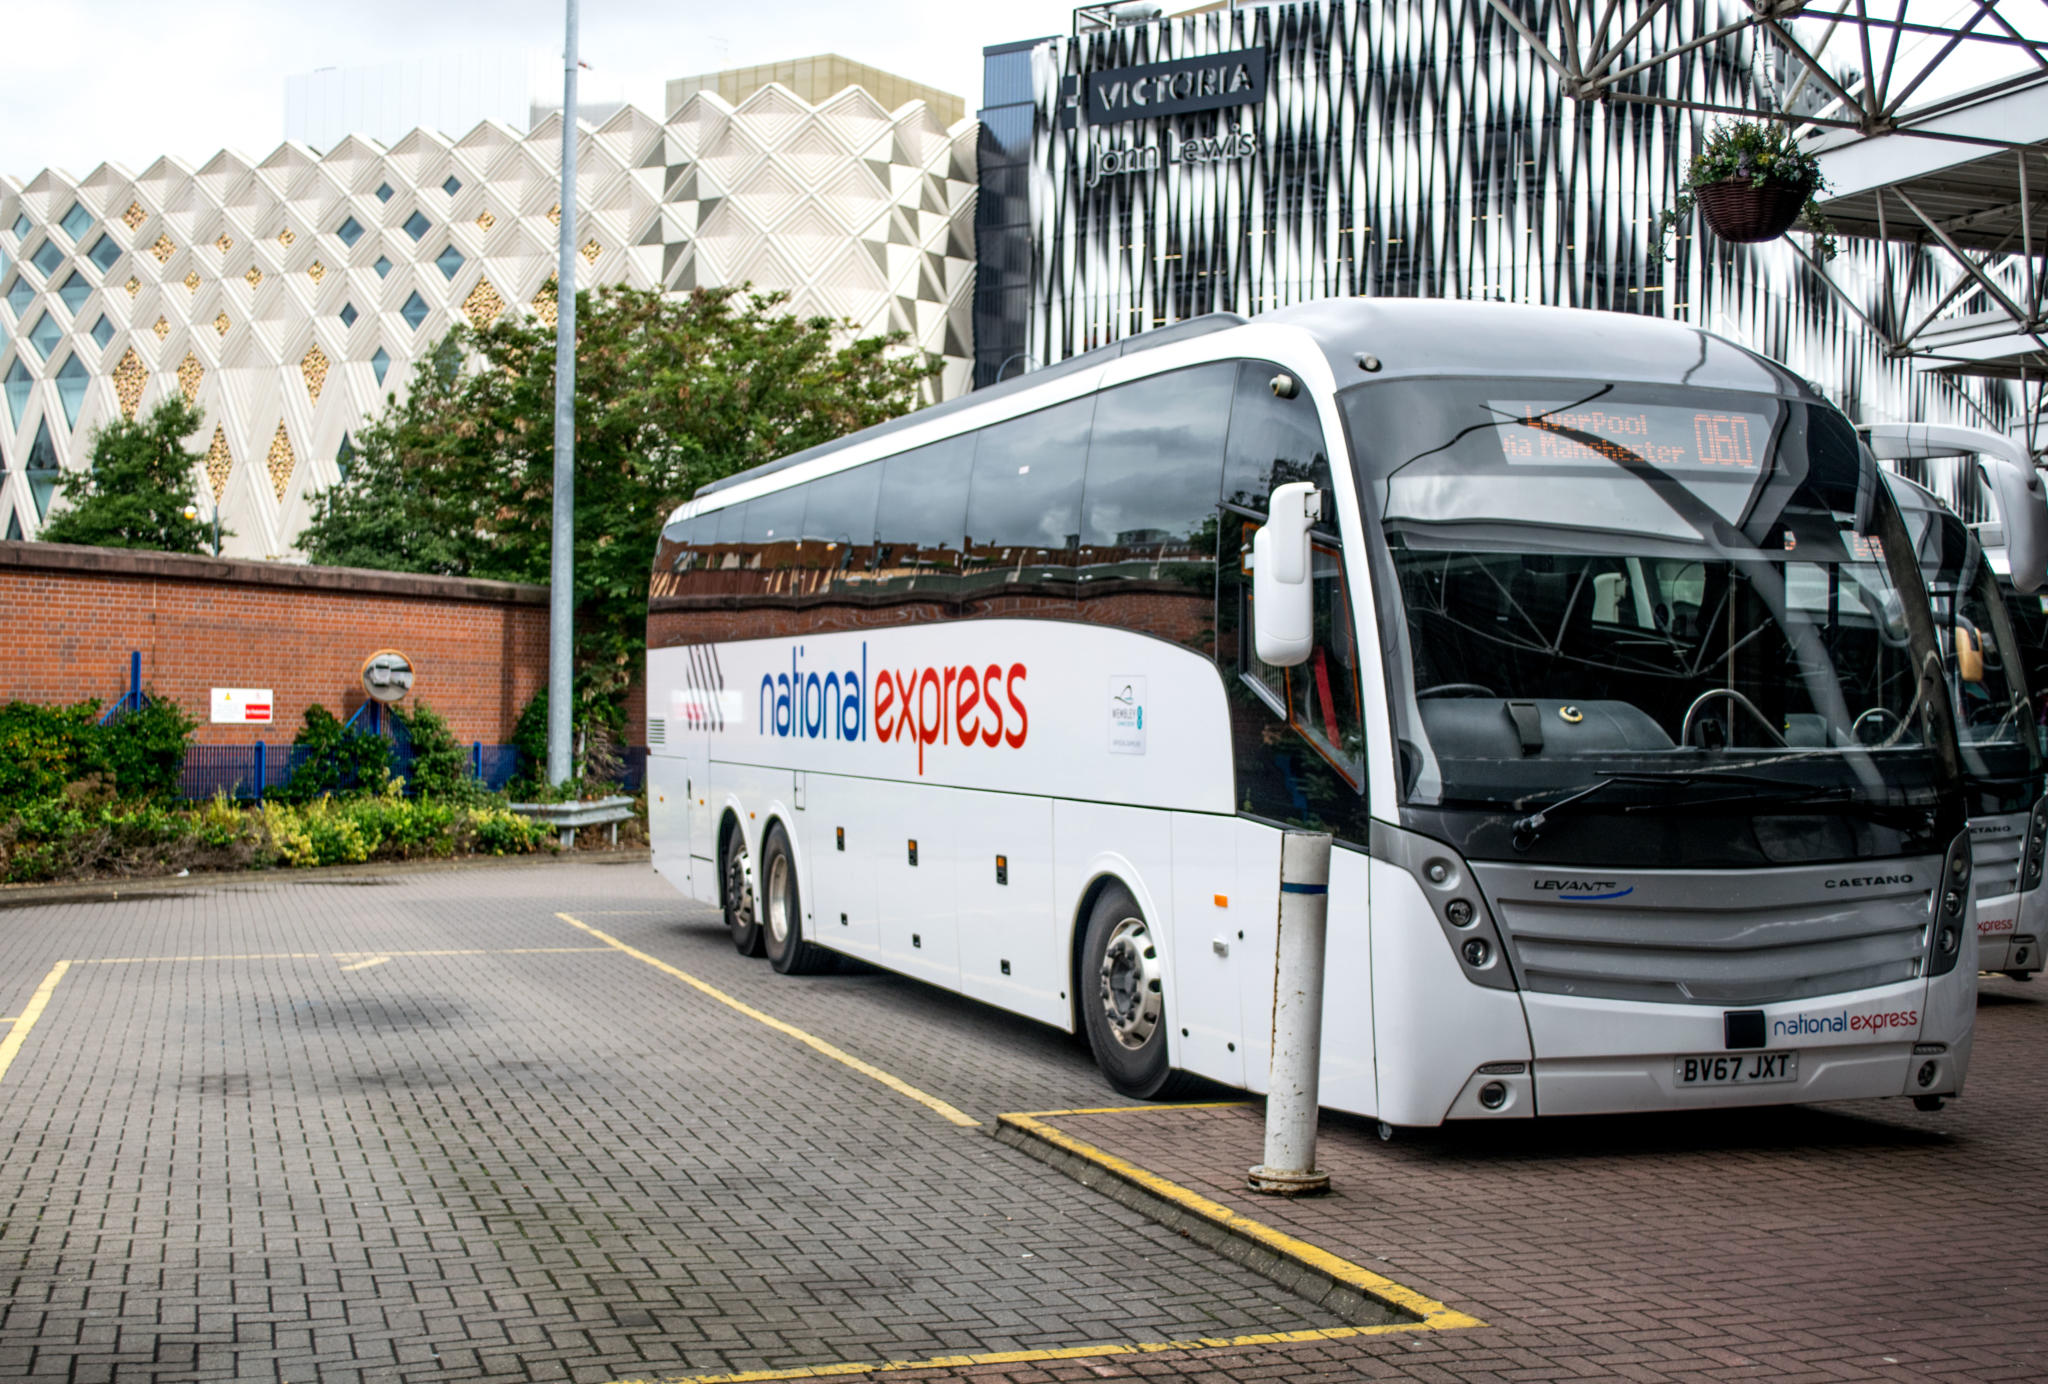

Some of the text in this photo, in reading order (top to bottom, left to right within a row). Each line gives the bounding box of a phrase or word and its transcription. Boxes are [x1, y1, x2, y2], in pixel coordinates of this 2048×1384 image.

[1098, 63, 1254, 111] VICTORIA
[1087, 122, 1257, 188] John Lewis
[1539, 431, 1685, 463] Manchester
[1694, 413, 1753, 466] 060
[760, 641, 1029, 776] national express
[1970, 825, 2011, 834] ETANO
[1534, 880, 1617, 891] LEVANTE
[1824, 874, 1914, 889] CAETANO
[1977, 919, 2013, 934] xpress
[1774, 1010, 1918, 1037] national express
[1683, 1054, 1790, 1082] BV67 JXT
